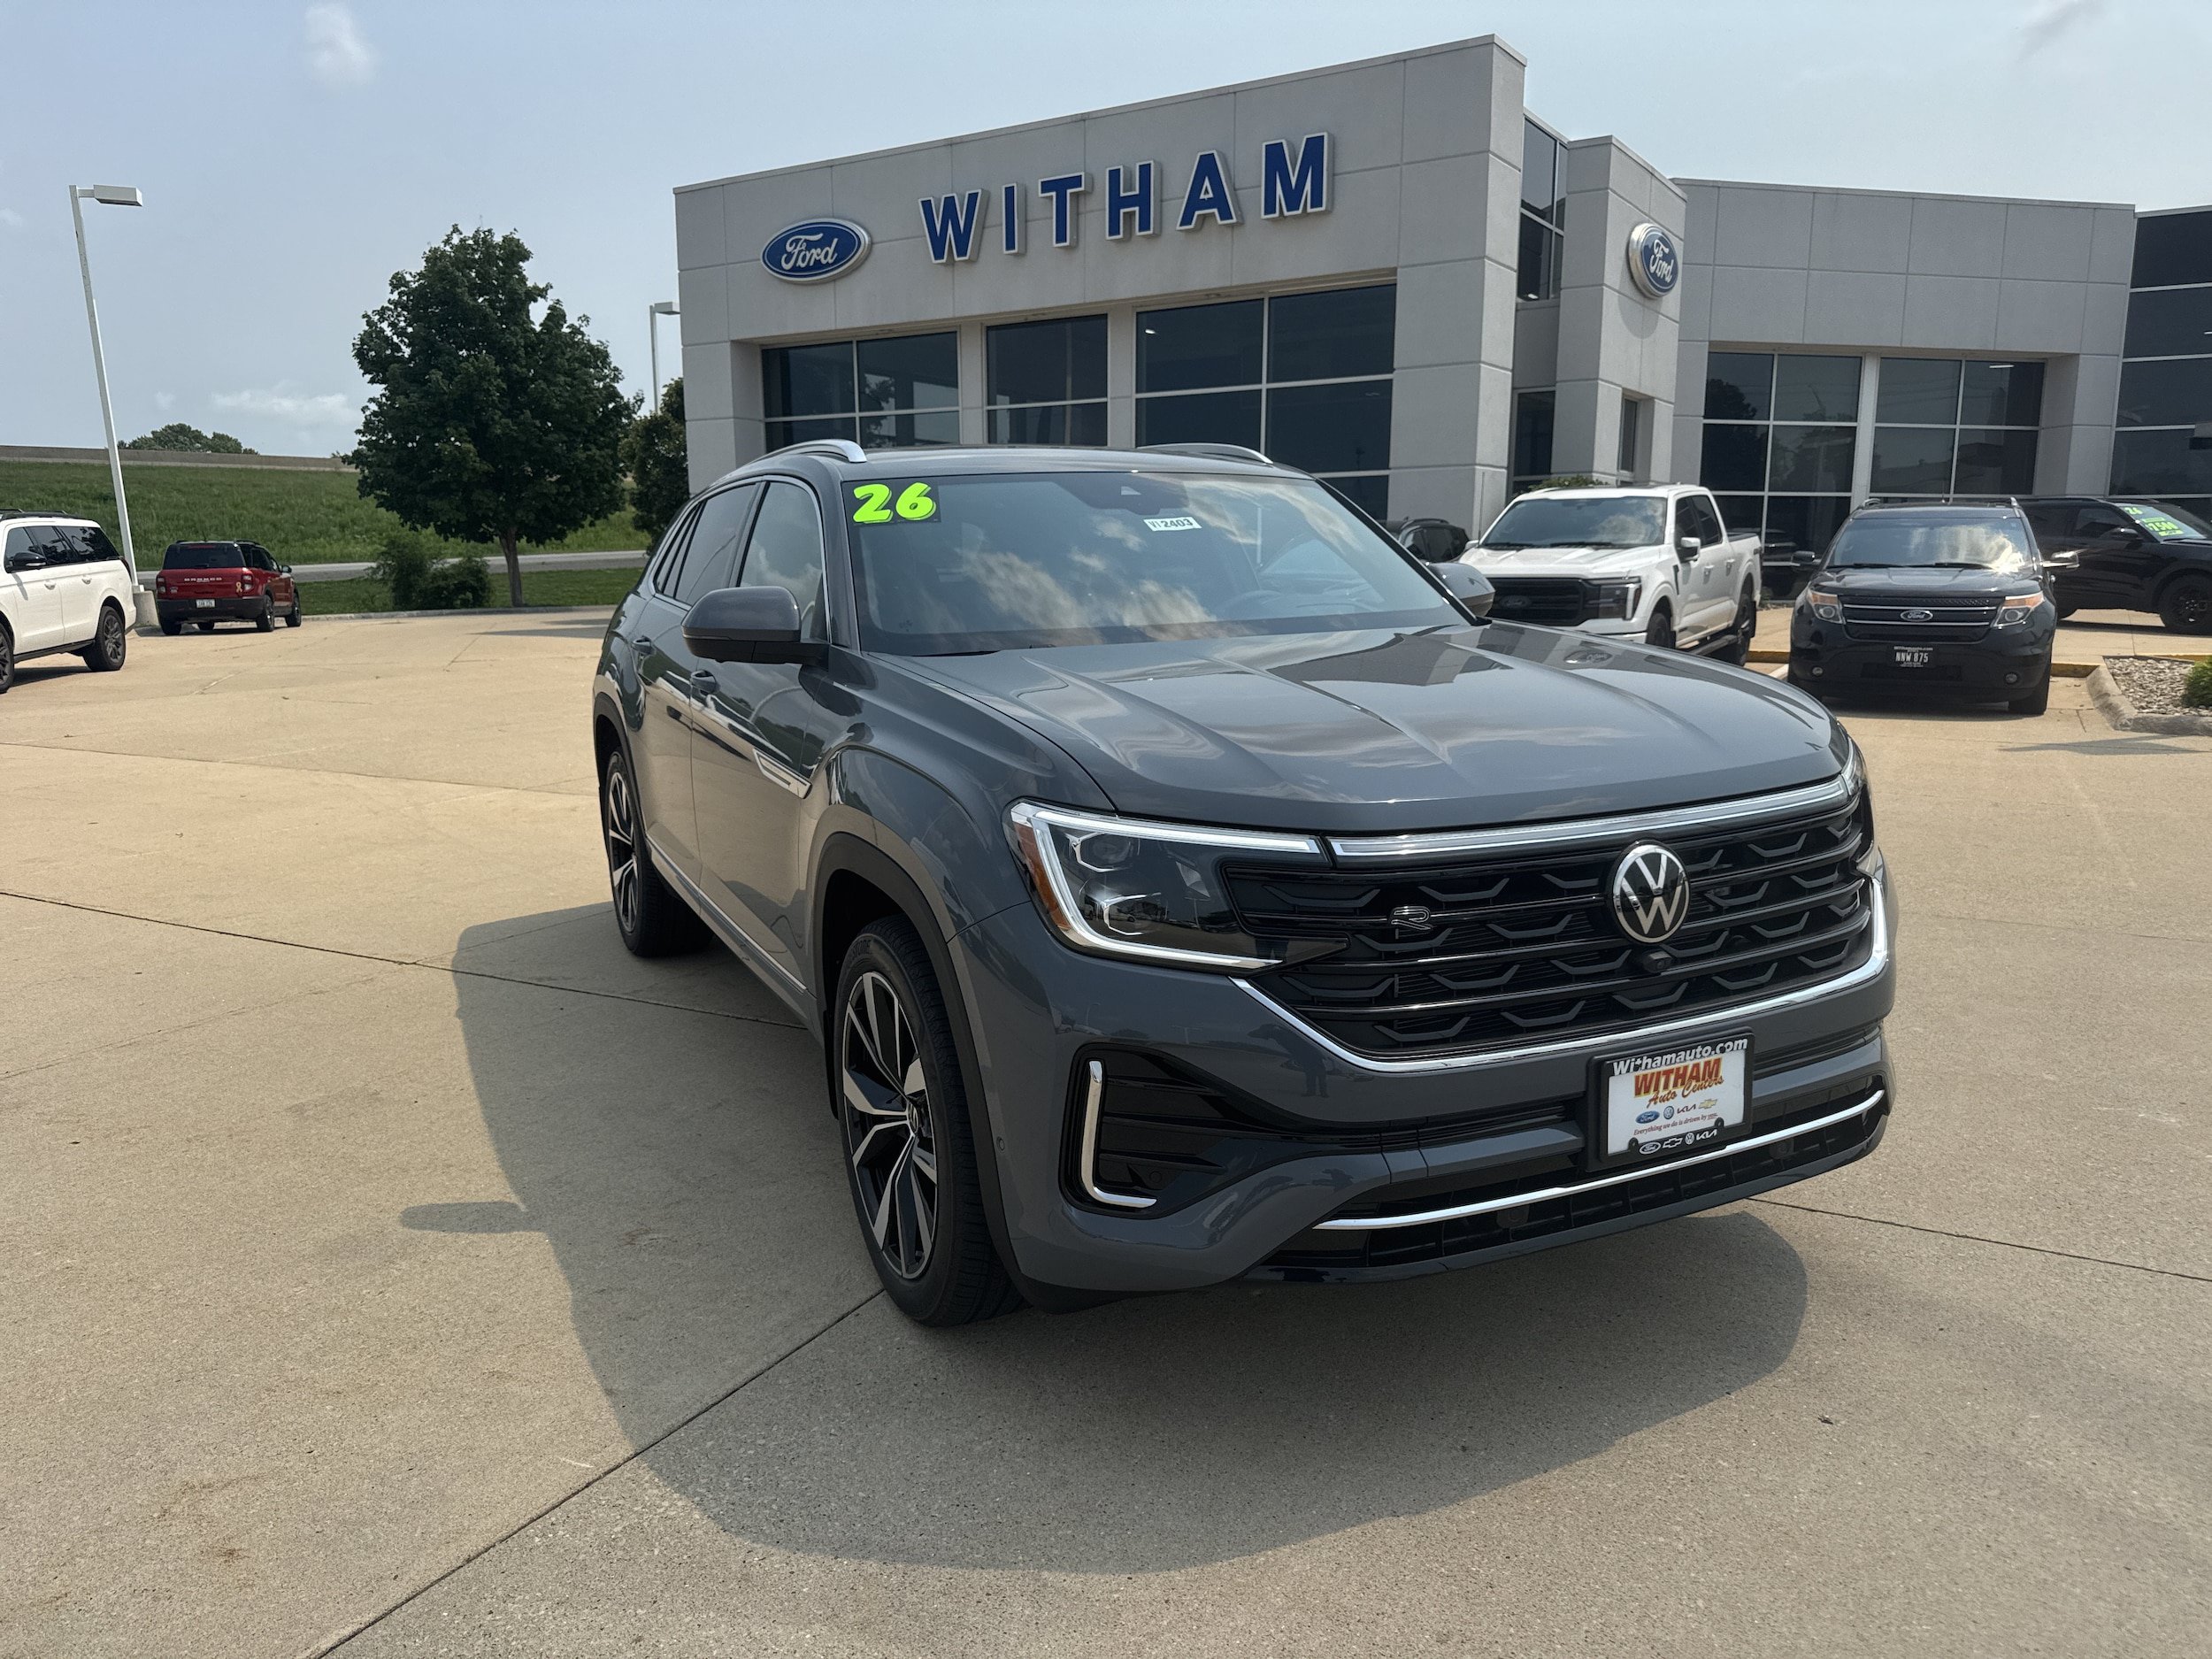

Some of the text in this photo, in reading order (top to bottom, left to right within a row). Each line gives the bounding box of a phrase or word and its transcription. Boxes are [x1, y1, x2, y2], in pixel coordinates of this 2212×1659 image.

[918, 132, 1332, 265] WITHAM
[780, 233, 838, 270] Ford
[1649, 239, 1674, 283] Ford
[852, 481, 937, 524] 26
[1913, 652, 1929, 663] 875
[1612, 1038, 1748, 1077] Withamauto.com
[1633, 1057, 1722, 1097] WITHAM
[1646, 1075, 1724, 1109] Auto Centers
[1633, 1124, 1663, 1136] Everything
[1684, 1115, 1701, 1125] driven
